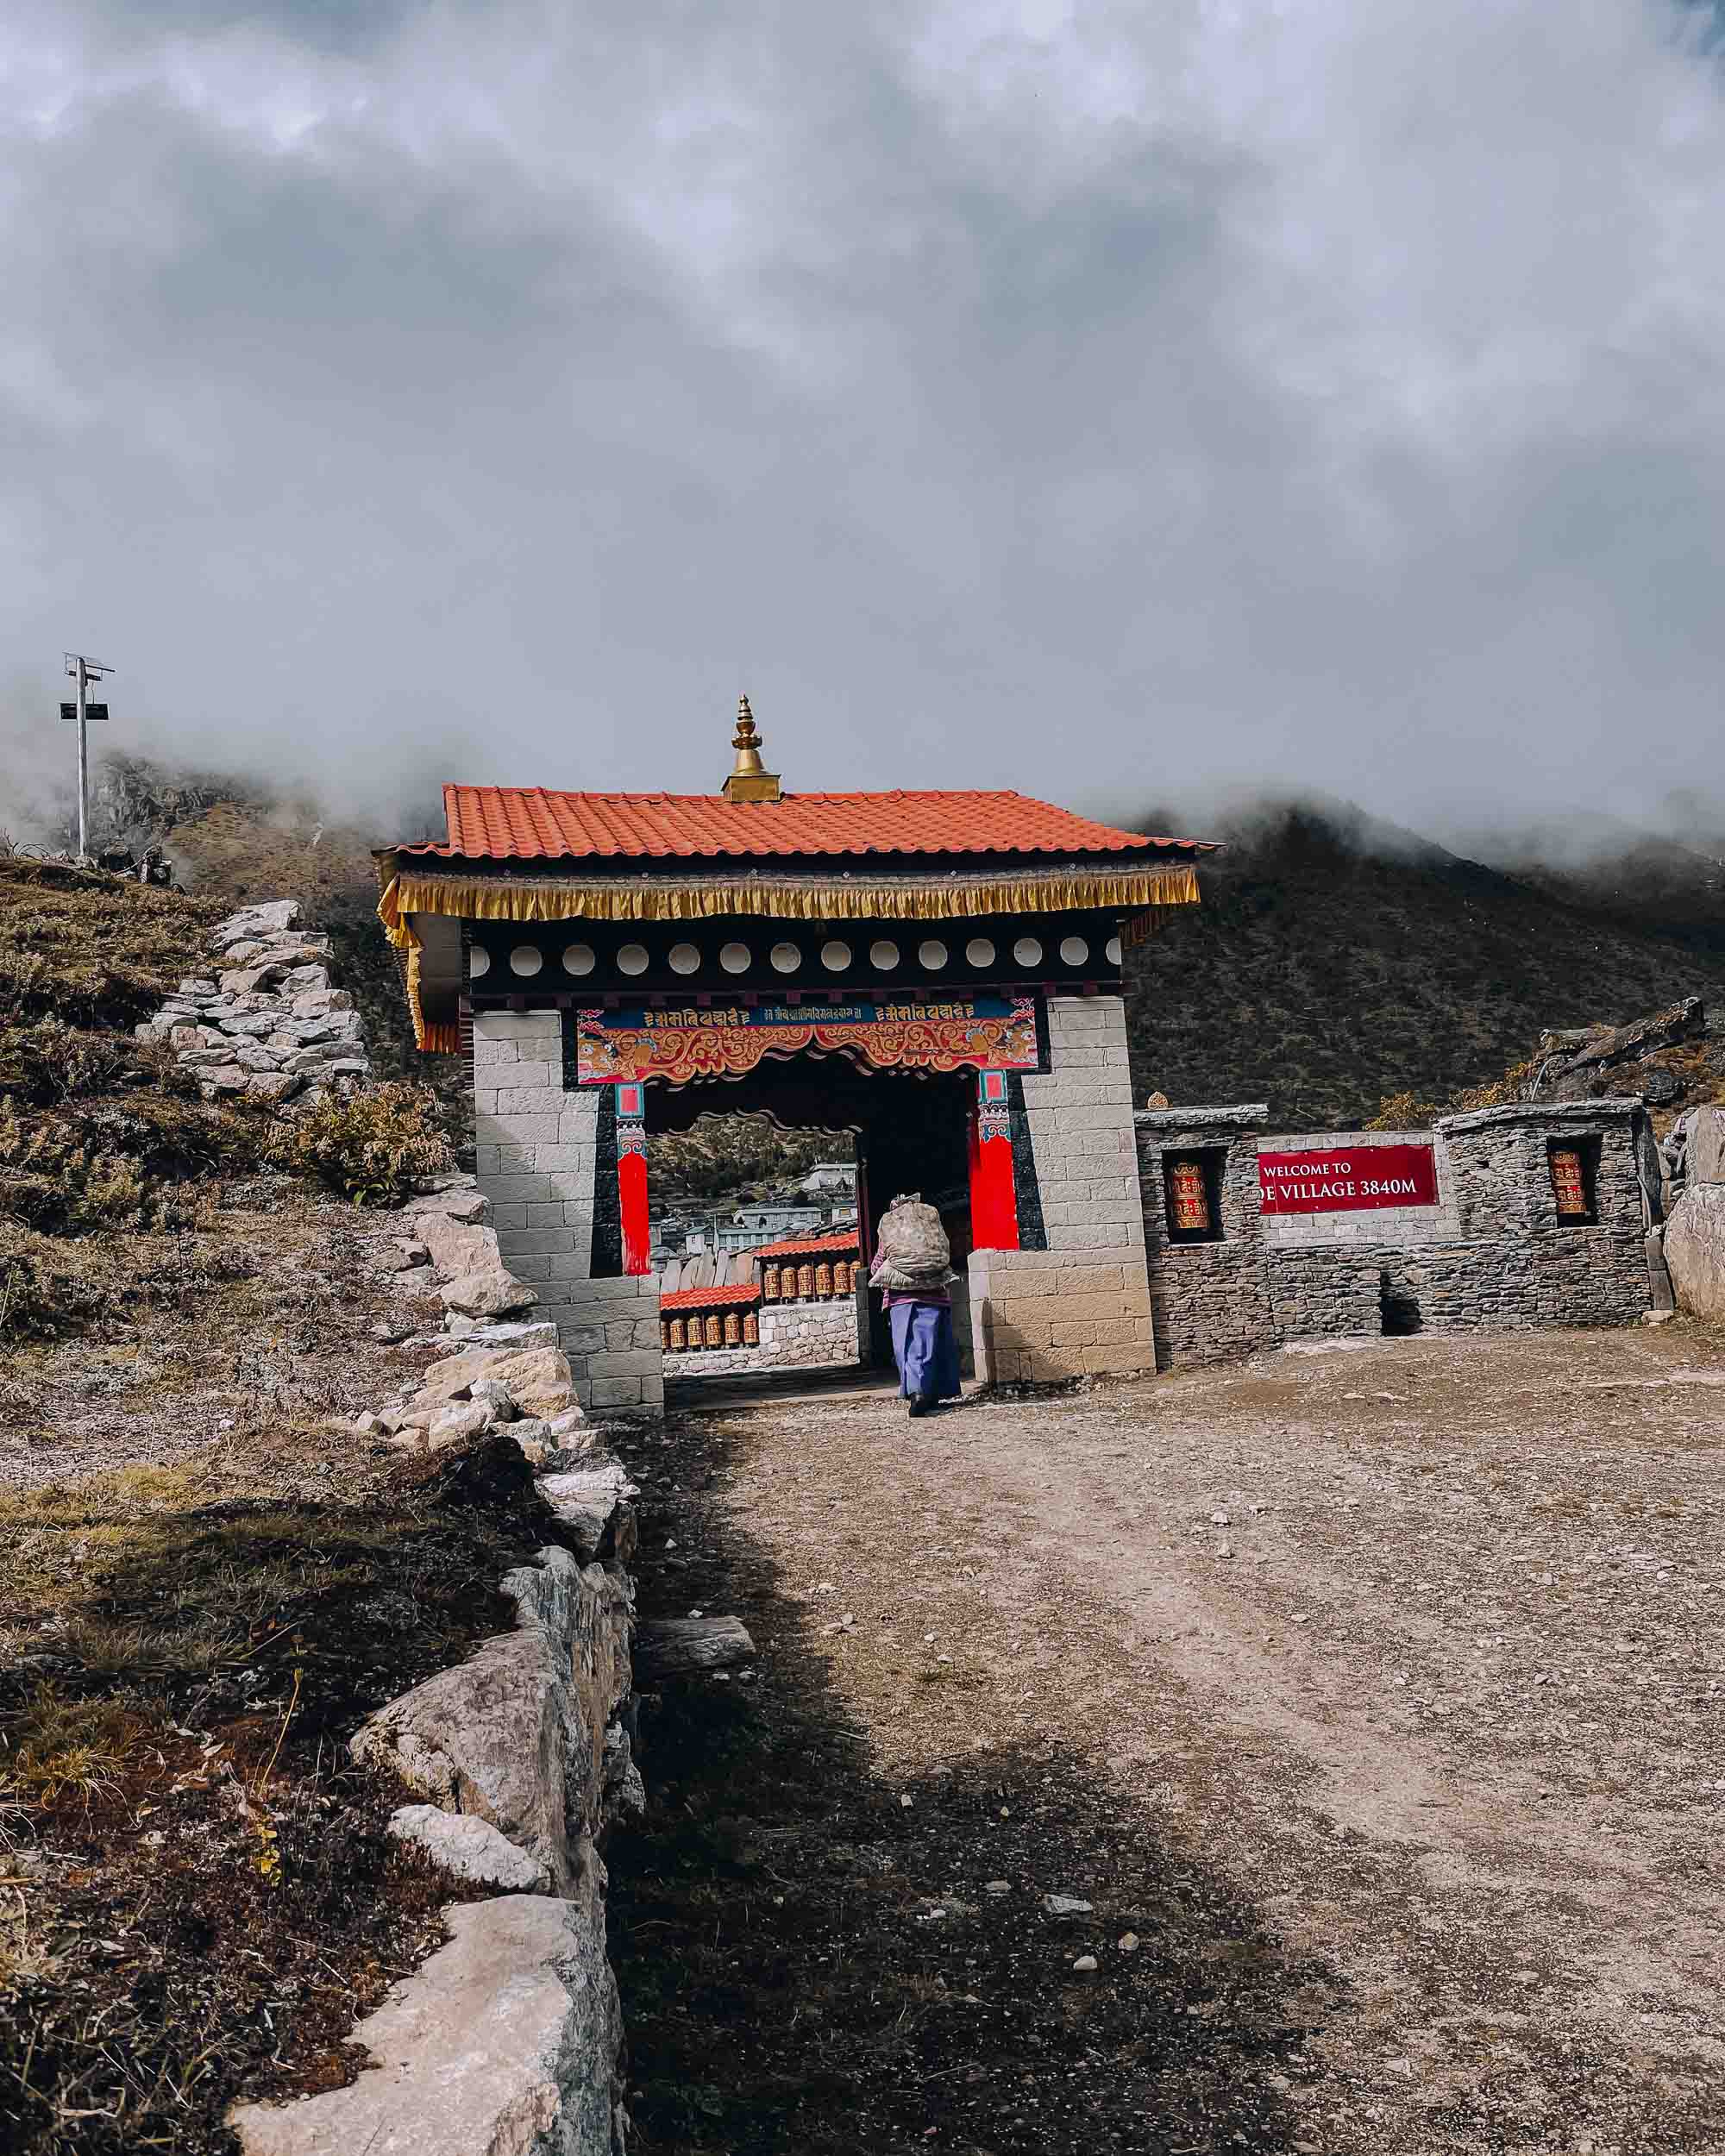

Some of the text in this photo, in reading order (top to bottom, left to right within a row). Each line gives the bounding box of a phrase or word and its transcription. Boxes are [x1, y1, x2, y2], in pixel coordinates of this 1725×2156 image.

[1264, 1162, 1352, 1177] WELCOME TO
[1279, 1181, 1355, 1200] VILLAGE
[1360, 1179, 1417, 1195] 3840M
